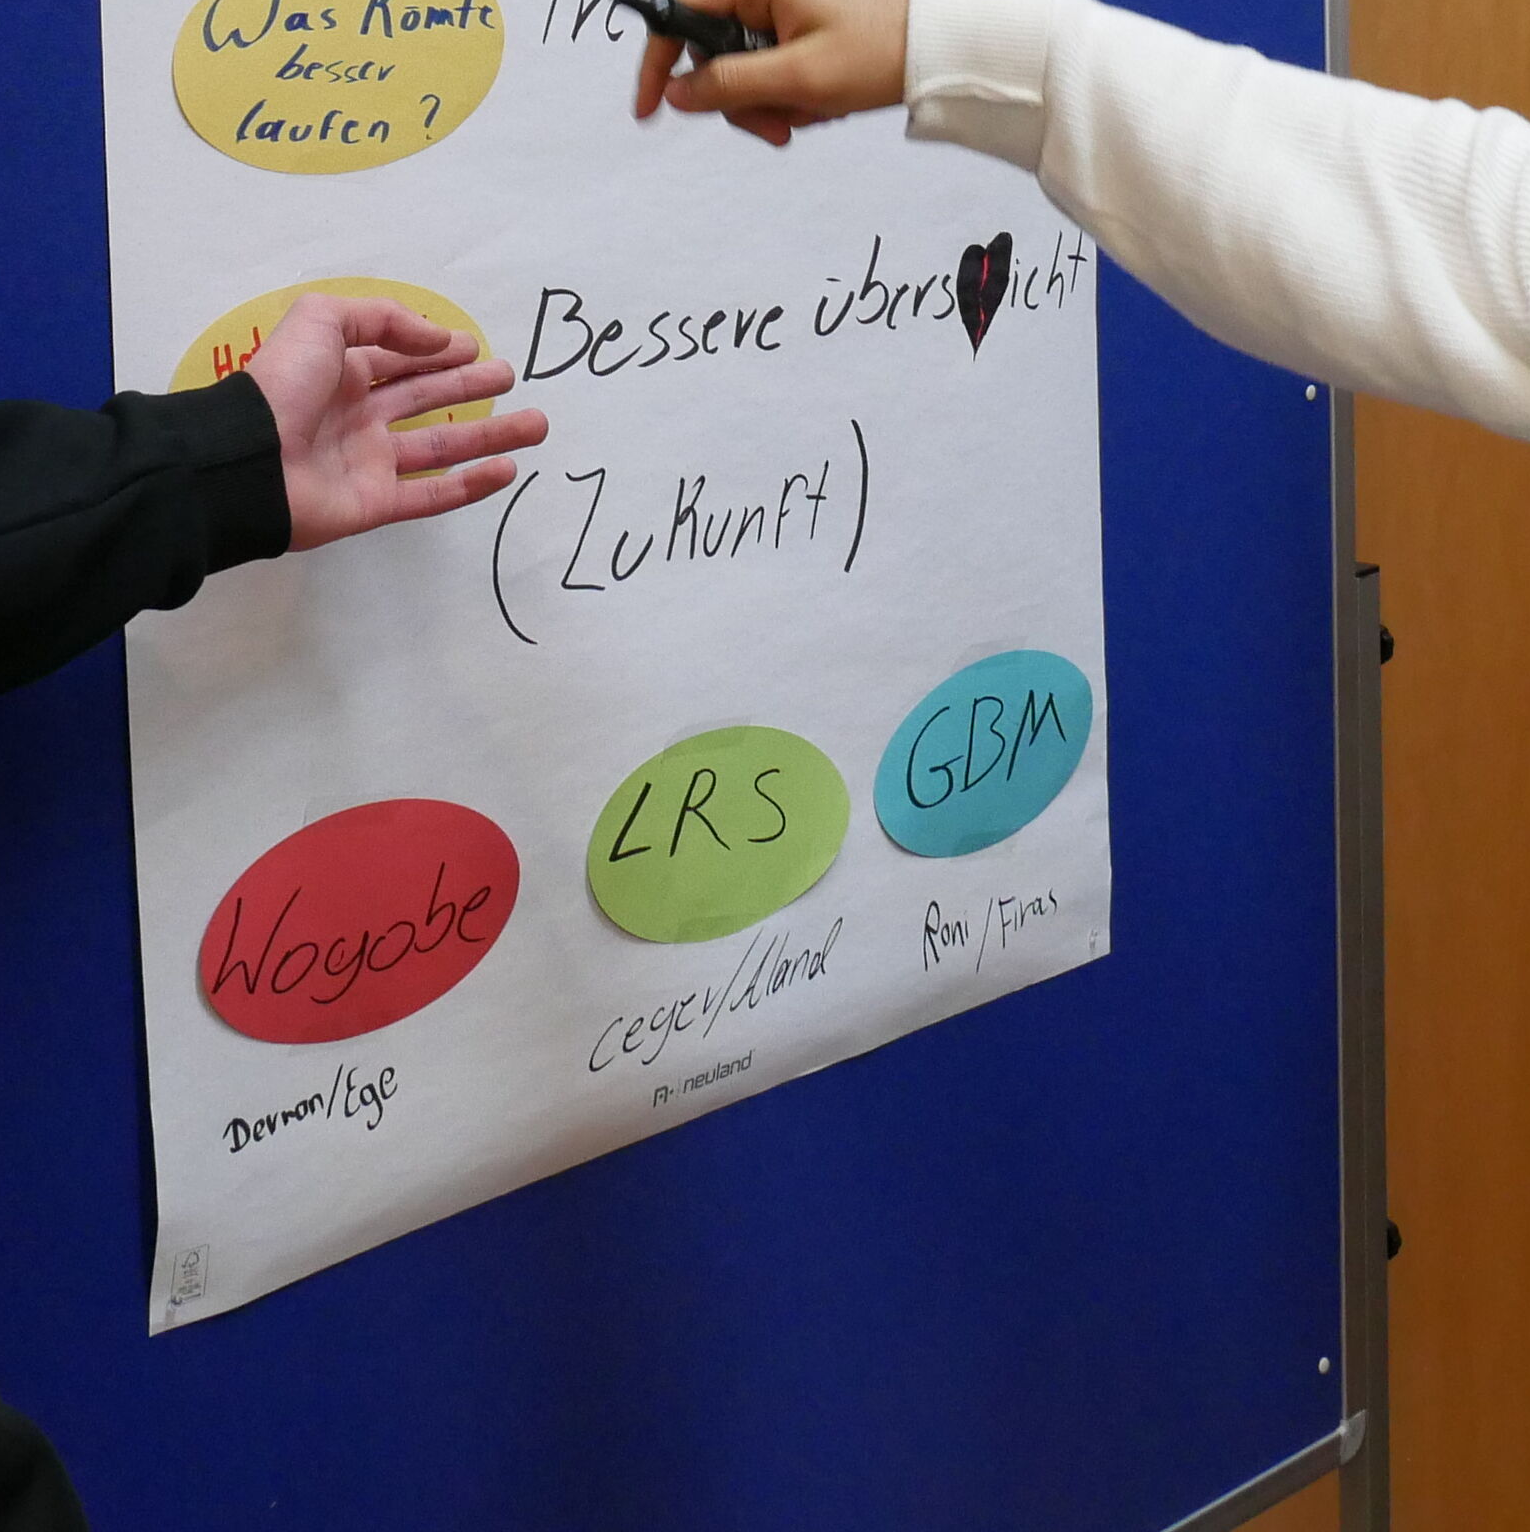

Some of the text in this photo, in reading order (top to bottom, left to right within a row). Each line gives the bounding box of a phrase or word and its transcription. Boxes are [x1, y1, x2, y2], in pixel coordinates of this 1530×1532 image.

[275, 43, 396, 83] besser
[236, 98, 390, 145] laufen
[522, 286, 784, 382] Bessere
[906, 689, 1067, 809] GBM
[608, 768, 787, 863] LRS
[682, 1049, 753, 1094] neuland
